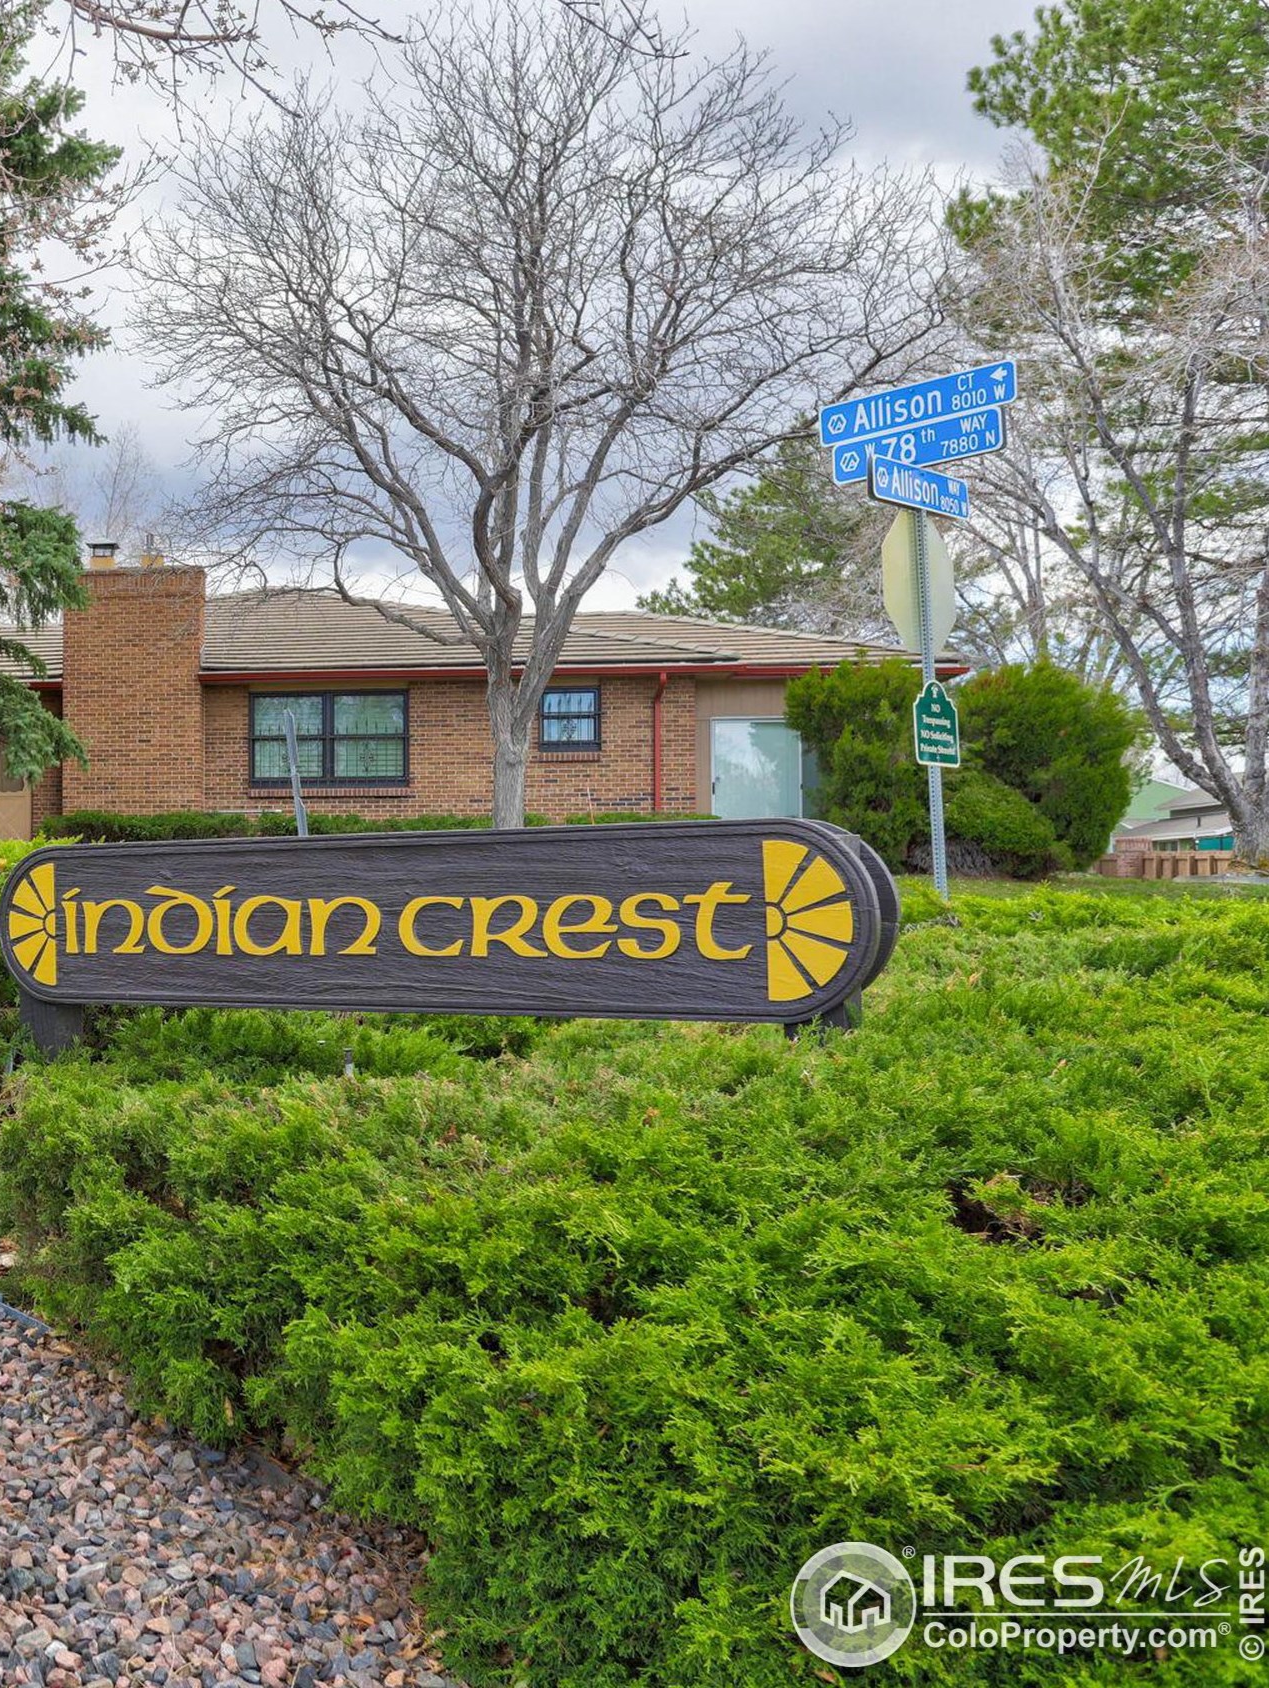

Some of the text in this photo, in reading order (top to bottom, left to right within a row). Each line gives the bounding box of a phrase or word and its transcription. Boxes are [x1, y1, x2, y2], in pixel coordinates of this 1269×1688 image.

[853, 373, 974, 433] Allison CT
[951, 384, 1006, 411] 8010 W
[960, 413, 989, 434] WAY
[940, 430, 995, 457] 7880 N
[892, 466, 960, 506] Allison WAY
[939, 495, 959, 514] 8050
